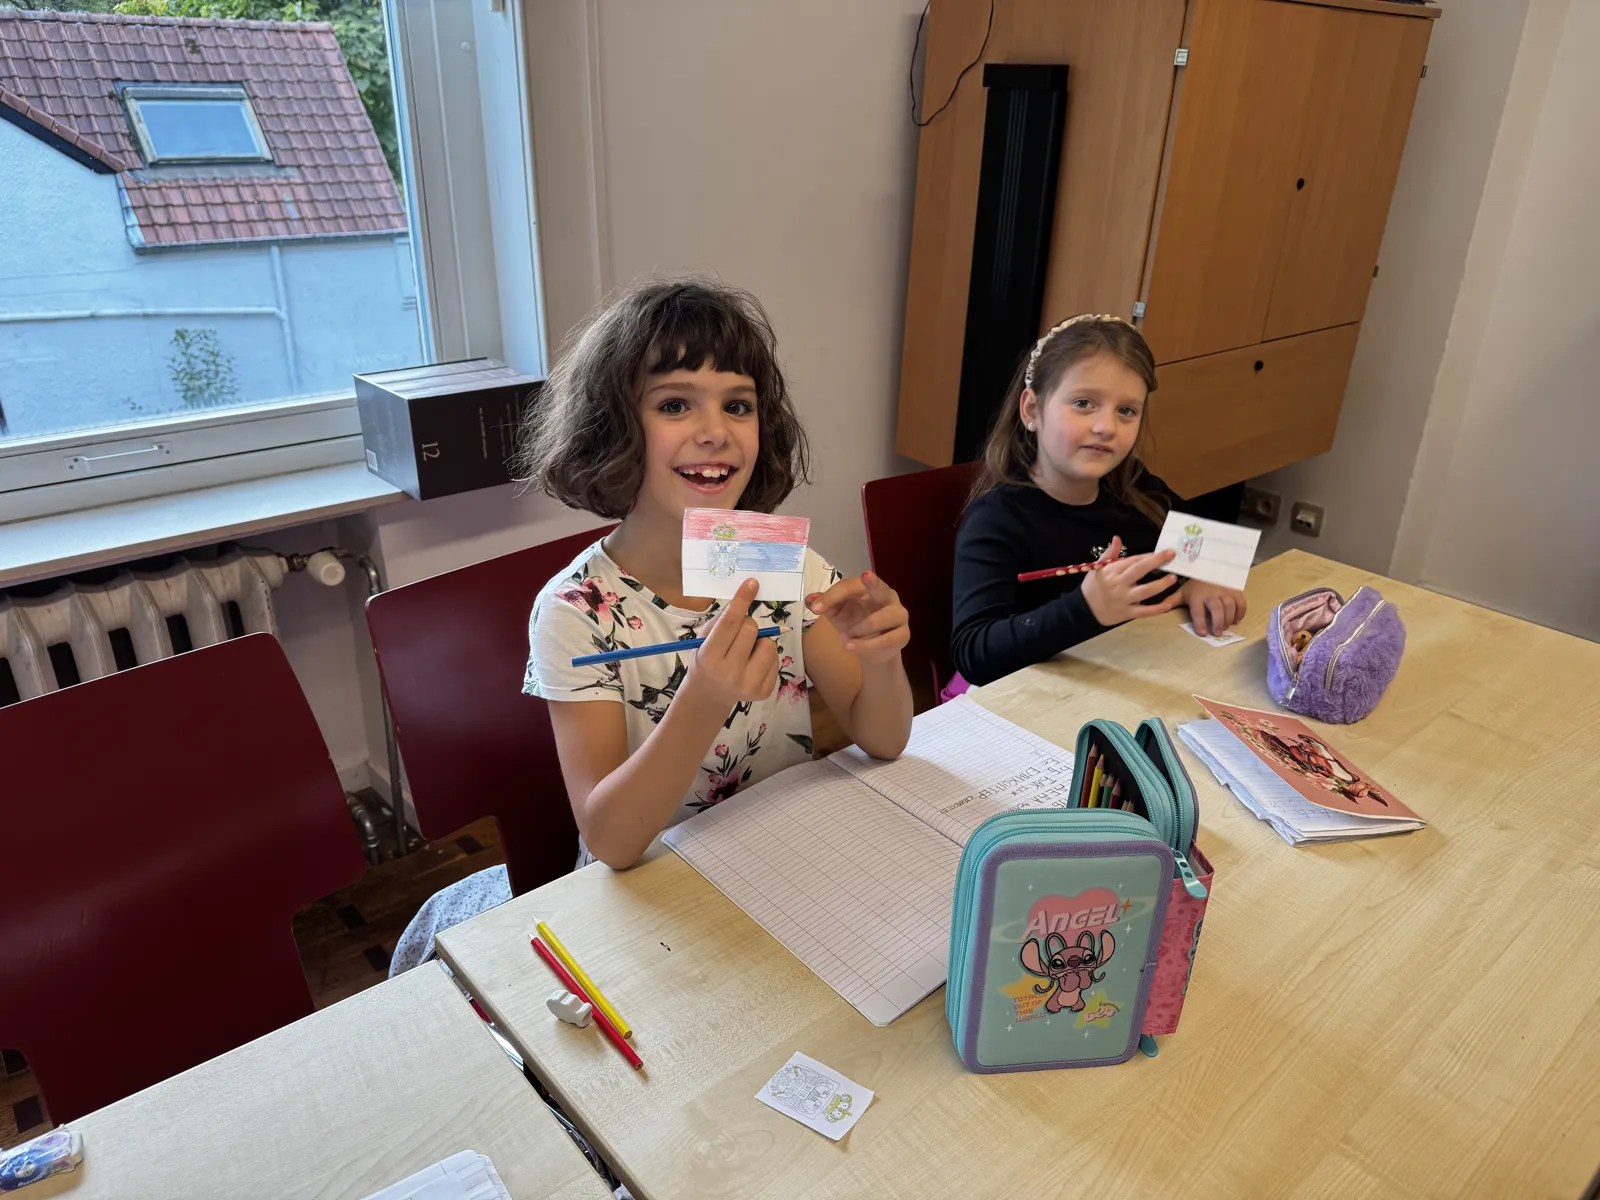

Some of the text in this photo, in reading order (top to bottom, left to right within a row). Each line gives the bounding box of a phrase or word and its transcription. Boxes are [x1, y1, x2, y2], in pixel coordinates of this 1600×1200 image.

[422, 441, 440, 461] 12
[1013, 1002, 1031, 1010] OUT
[1014, 1008, 1034, 1016] THIS
[1015, 1013, 1047, 1023] WORLD
